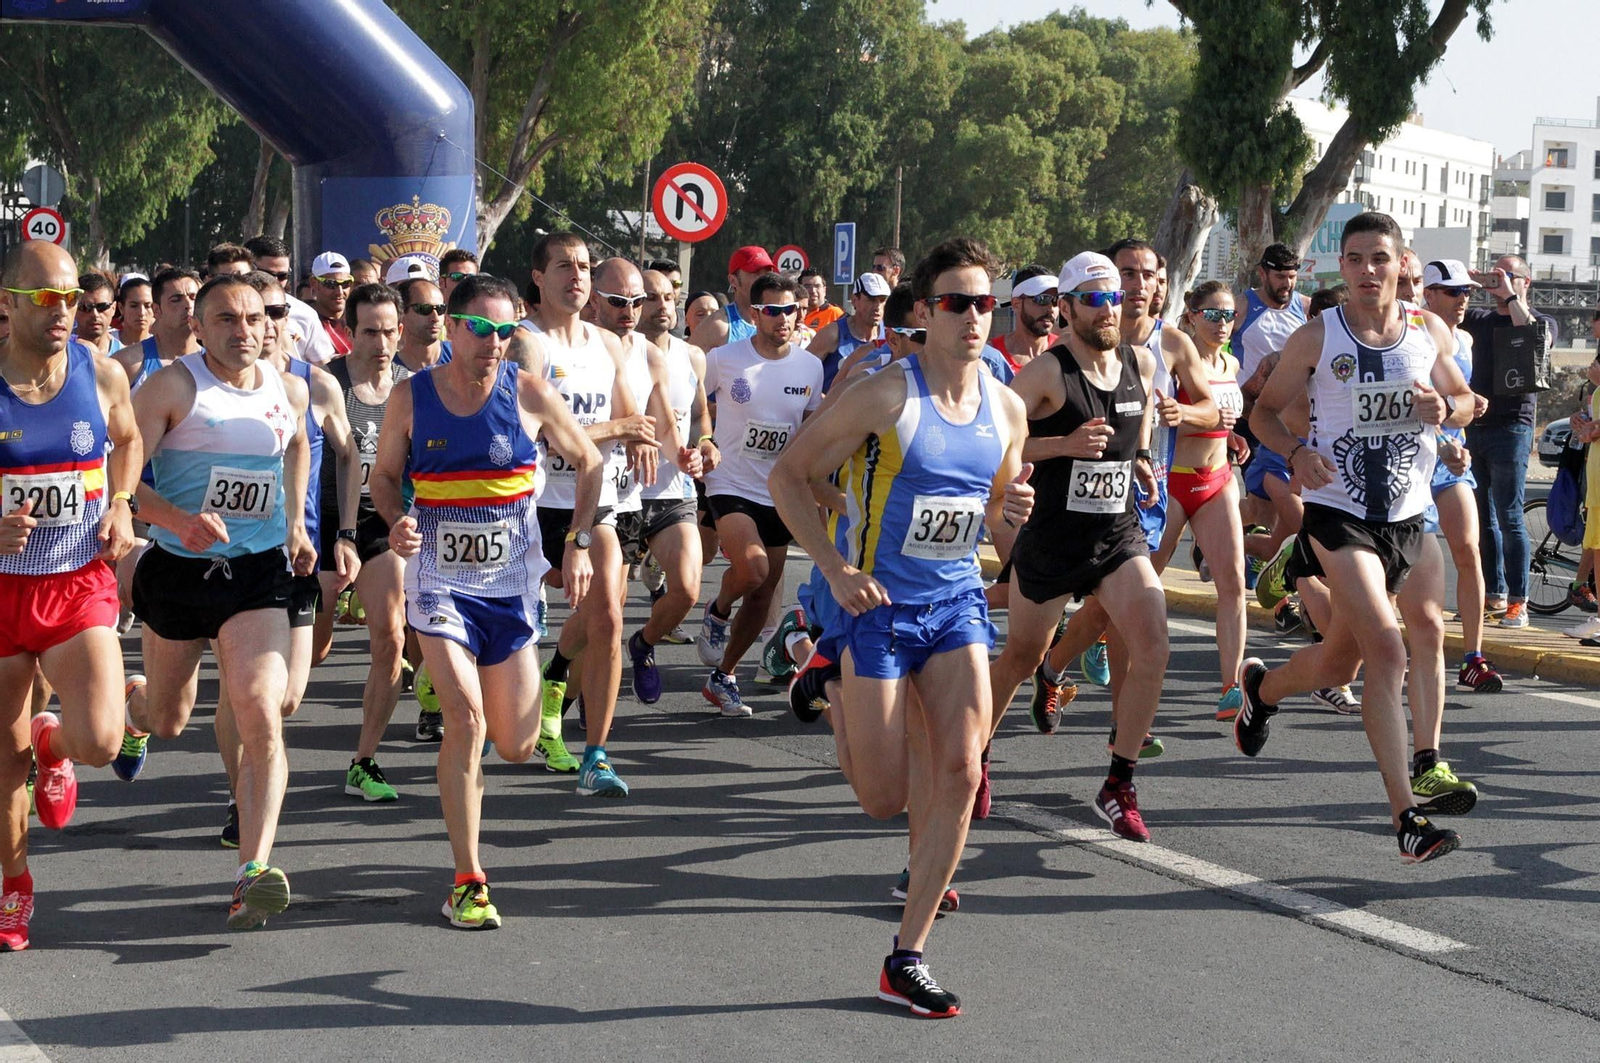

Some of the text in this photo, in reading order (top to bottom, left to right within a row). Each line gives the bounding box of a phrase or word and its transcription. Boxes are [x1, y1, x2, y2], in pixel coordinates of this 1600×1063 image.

[31, 221, 56, 236] 40
[781, 258, 802, 271] 40
[837, 231, 849, 276] P
[784, 386, 806, 396] CNP
[1358, 389, 1414, 422] 3269
[746, 428, 788, 452] 3289
[10, 484, 78, 518] 3204
[210, 479, 270, 512] 3301
[1074, 471, 1126, 499] 3283
[914, 509, 974, 544] 3251
[443, 531, 503, 563] 3205
